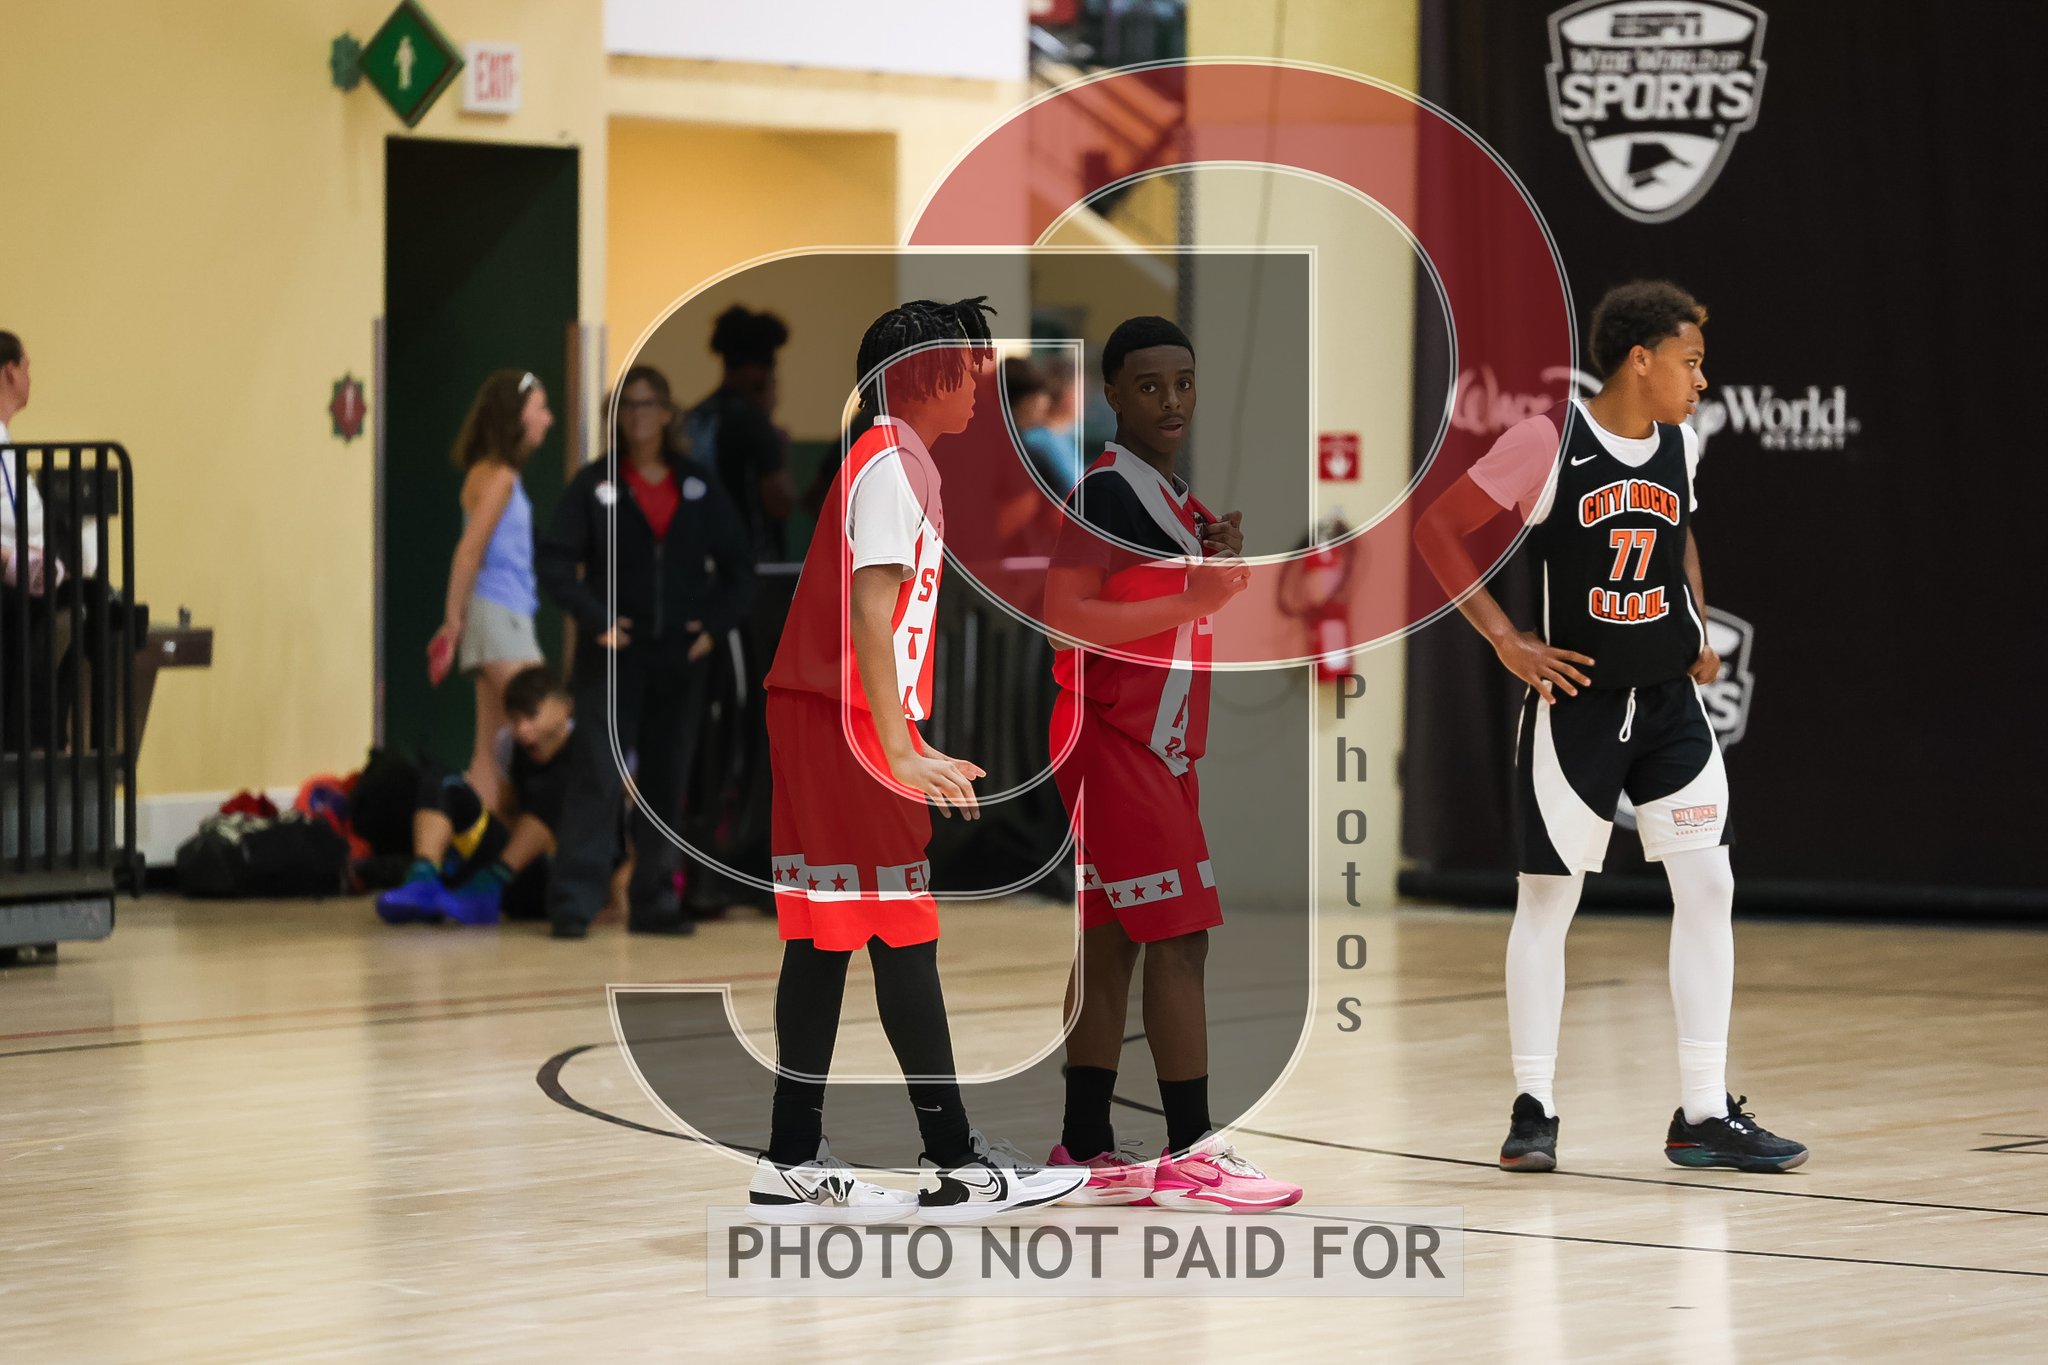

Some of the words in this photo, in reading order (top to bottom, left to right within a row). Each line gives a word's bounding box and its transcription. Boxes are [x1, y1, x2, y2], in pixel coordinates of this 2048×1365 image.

[1560, 70, 1755, 121] SPORTS
[1721, 384, 1847, 435] World
[1579, 480, 1627, 527] CITY
[1626, 479, 1680, 526] ROCKS
[1609, 529, 1657, 581] 77
